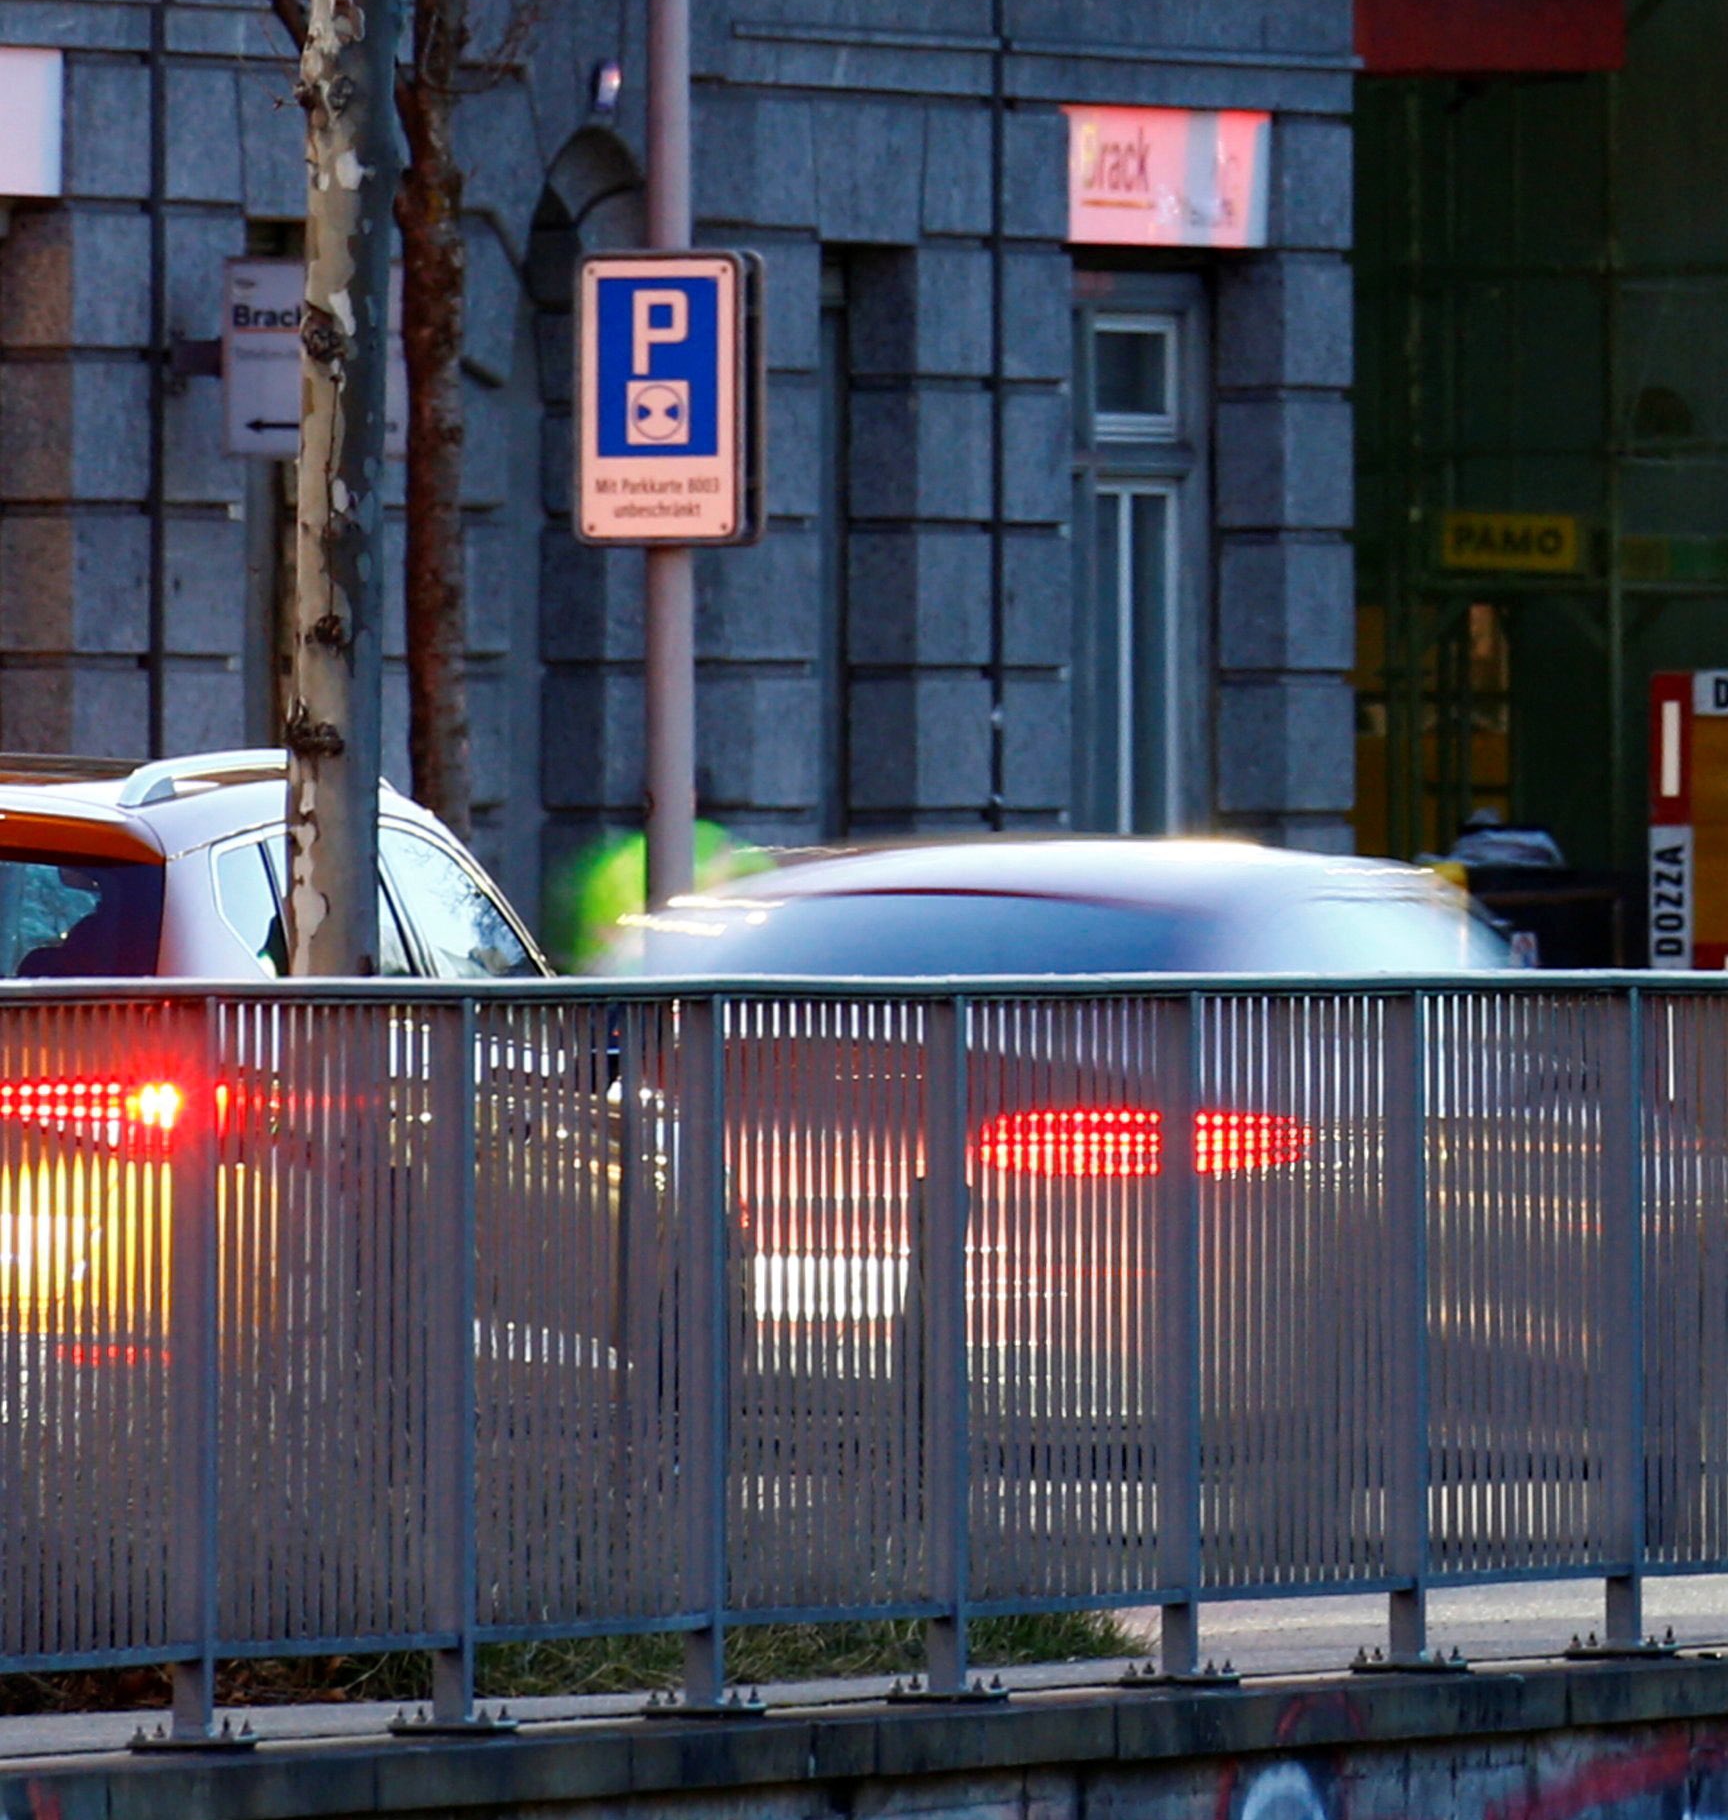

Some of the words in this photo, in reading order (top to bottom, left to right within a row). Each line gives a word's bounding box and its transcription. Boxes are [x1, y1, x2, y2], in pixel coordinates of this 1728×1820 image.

[632, 288, 688, 375] P
[1453, 523, 1564, 556] PAMO
[1654, 843, 1685, 958] DOZZA
